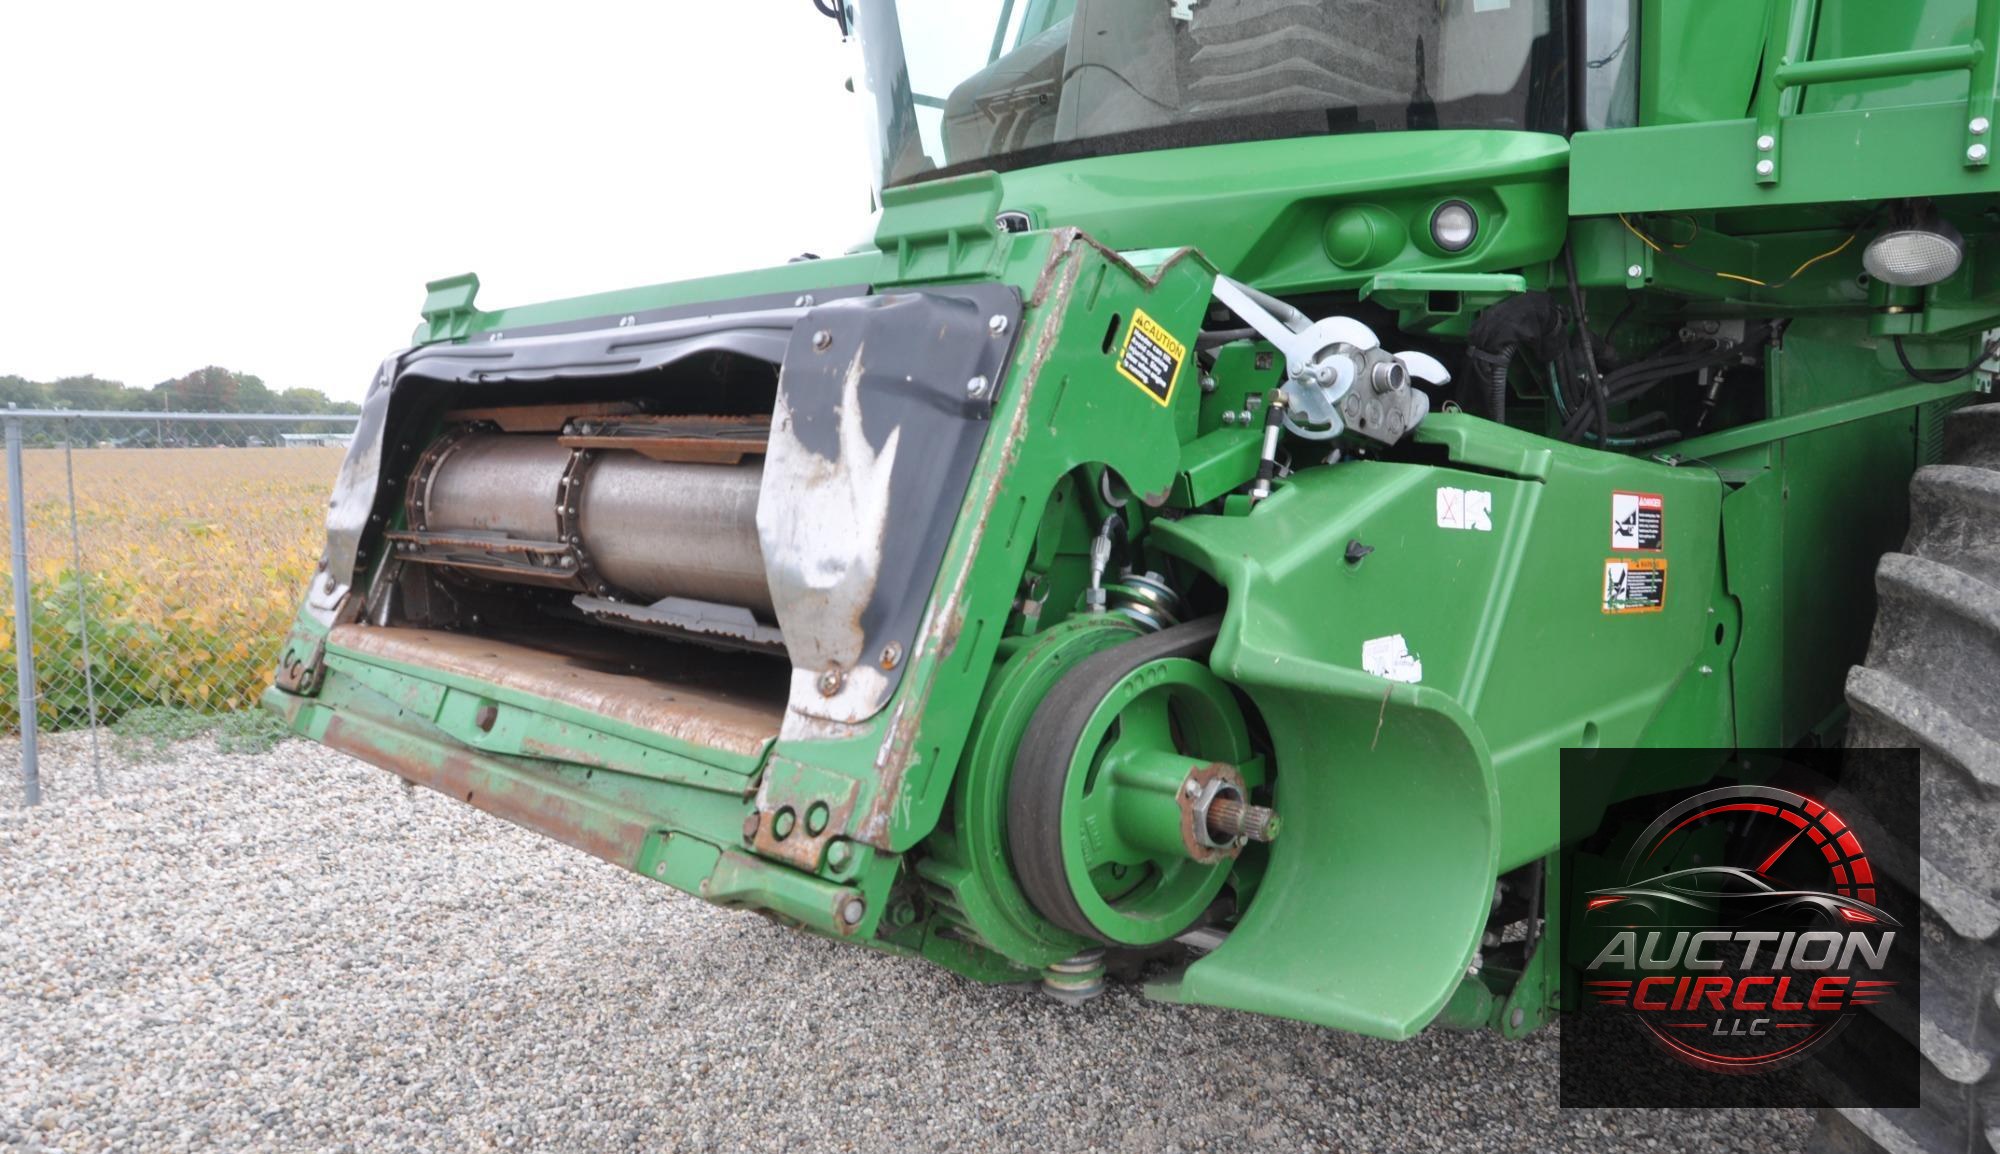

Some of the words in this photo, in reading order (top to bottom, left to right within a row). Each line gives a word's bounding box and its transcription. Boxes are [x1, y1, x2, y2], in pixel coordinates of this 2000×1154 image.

[1133, 328, 1152, 347] Header
[1151, 344, 1163, 356] can
[1143, 320, 1182, 357] CAUTION
[1130, 335, 1147, 352] Avoid
[1145, 348, 1169, 372] crushing
[1148, 359, 1162, 375] Stay
[1149, 371, 1167, 388] engine
